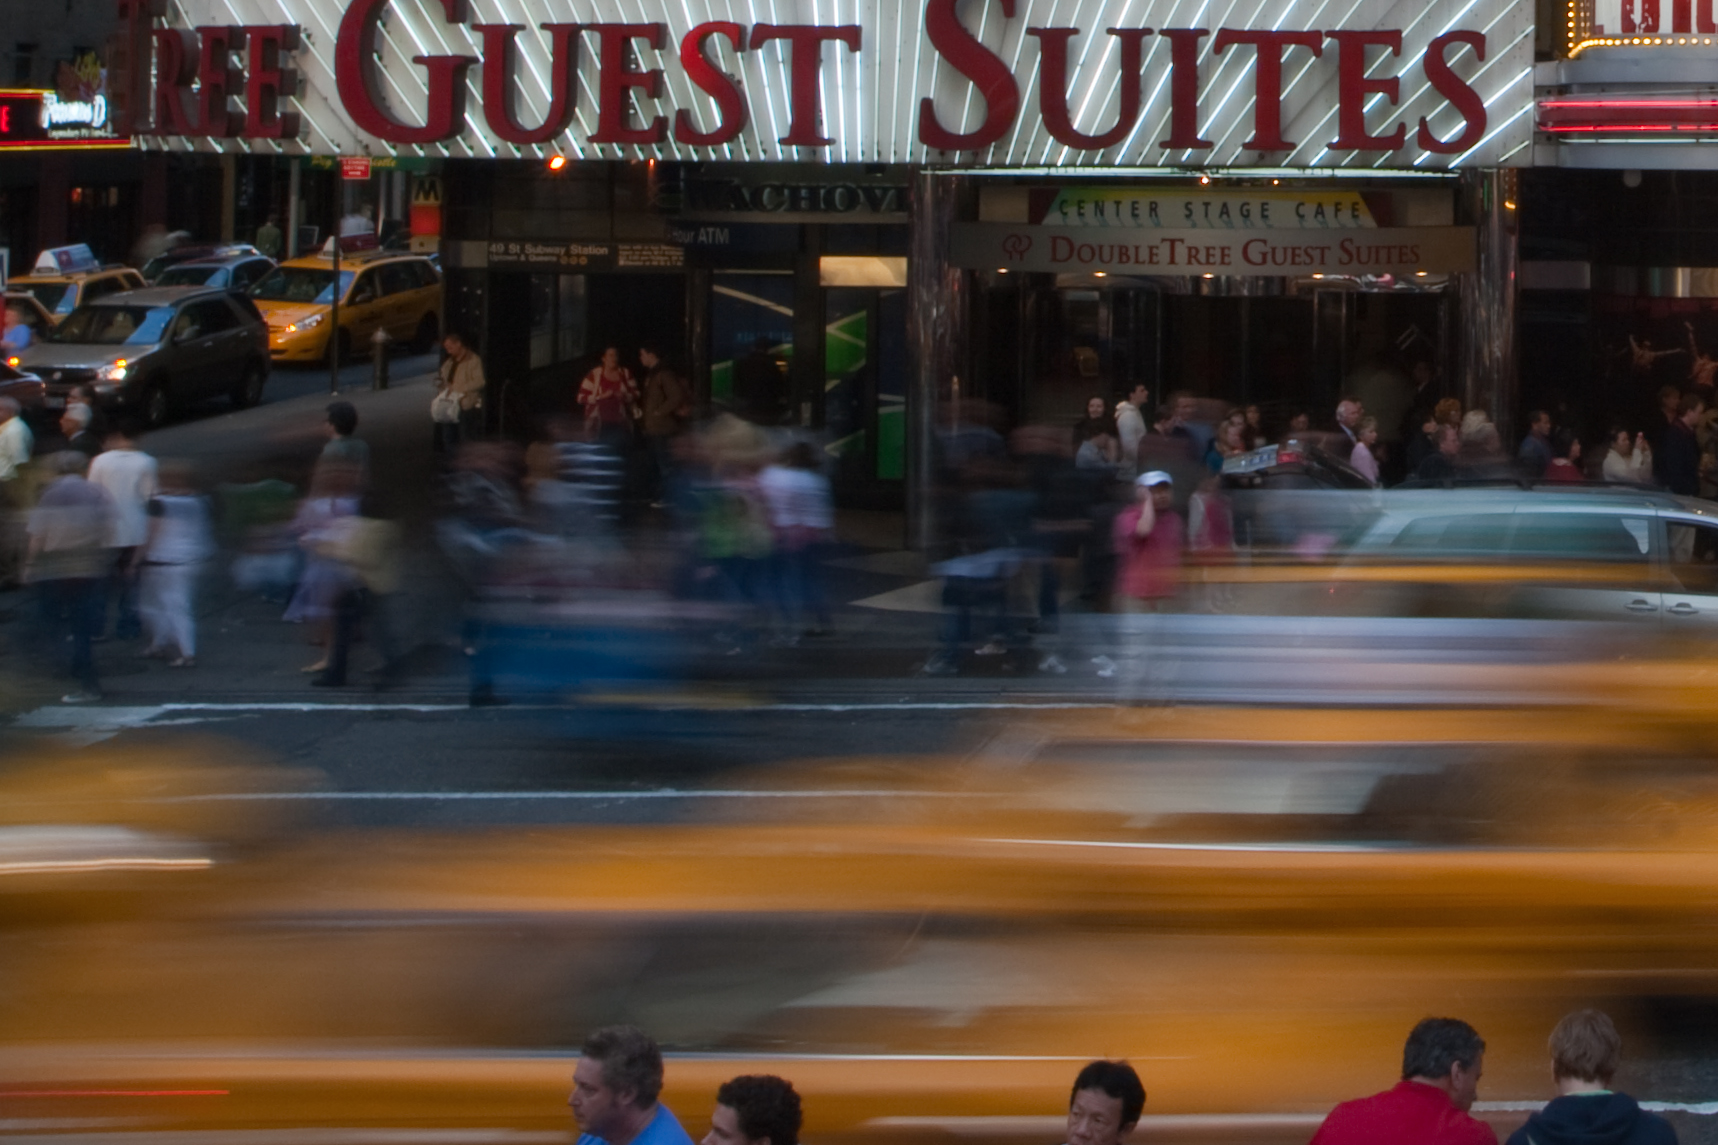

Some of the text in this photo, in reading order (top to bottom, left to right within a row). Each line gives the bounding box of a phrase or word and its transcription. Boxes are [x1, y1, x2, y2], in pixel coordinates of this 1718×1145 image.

[1059, 200, 1362, 220] CENTER STAGE CAFE
[697, 228, 731, 245] ATM
[489, 243, 504, 254] 49
[508, 243, 521, 254] St
[525, 243, 566, 257] Subway
[570, 243, 608, 255] Station
[1242, 238, 1332, 265] GUEST
[1339, 239, 1421, 265] SUITES
